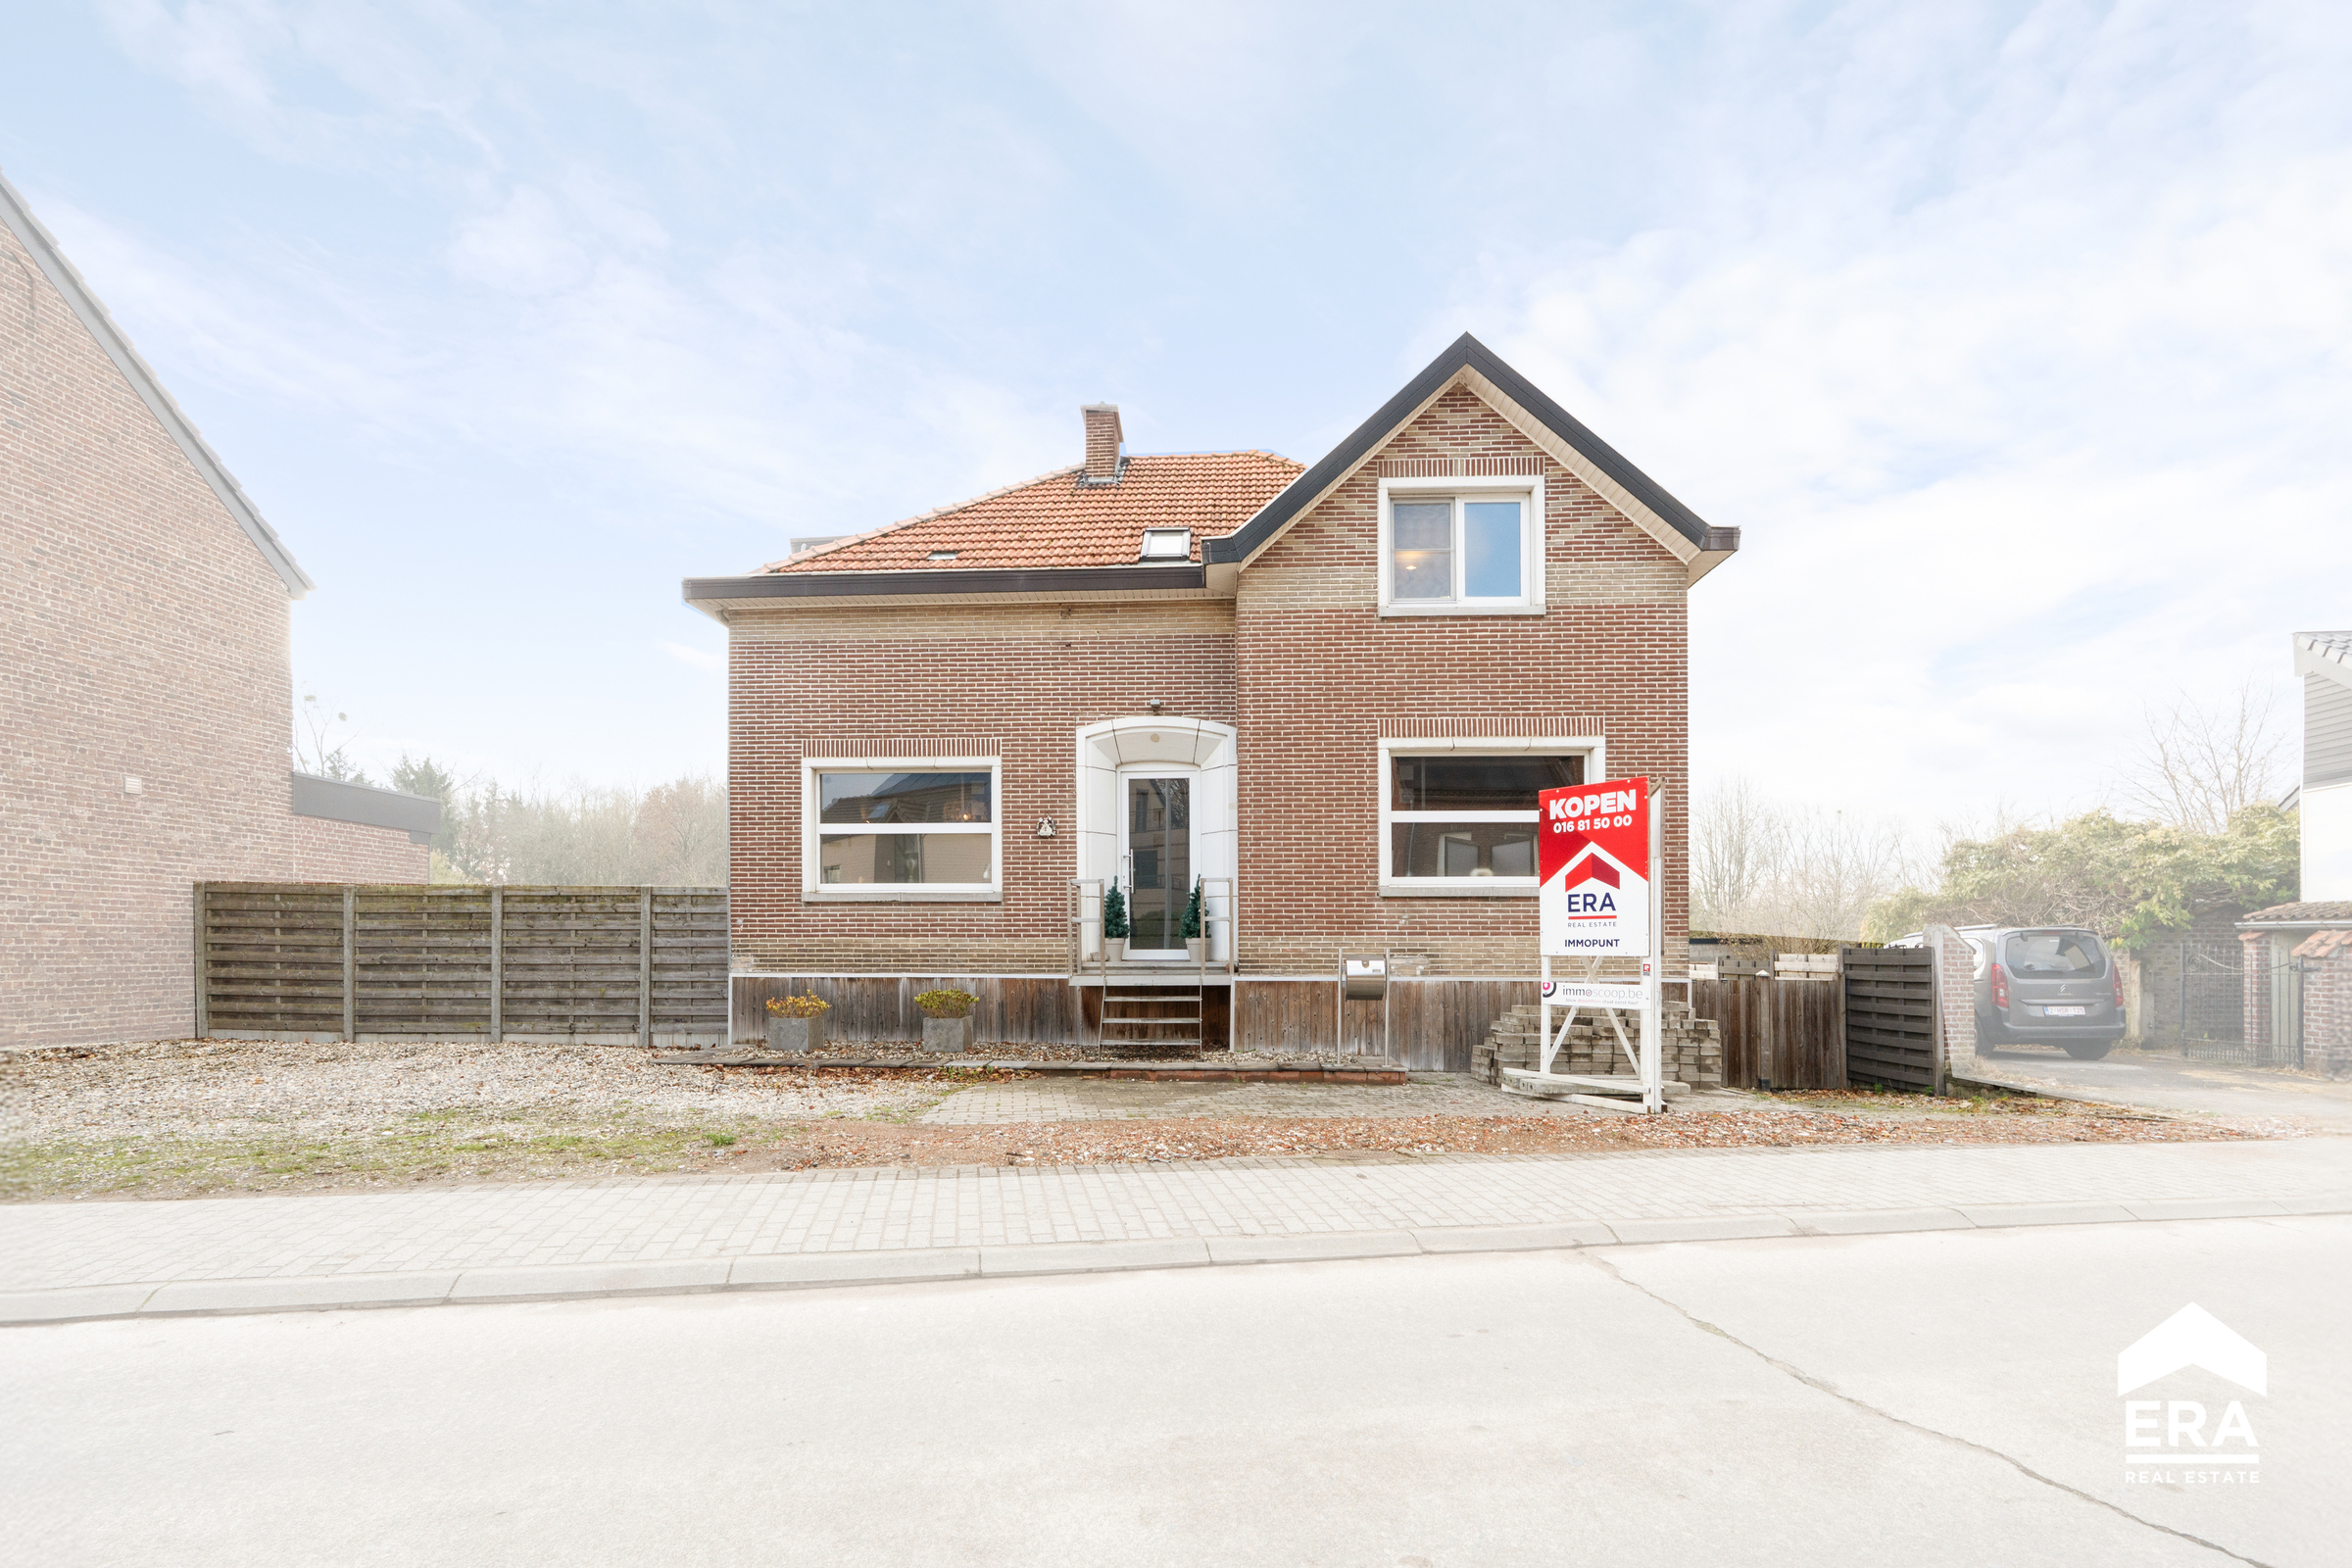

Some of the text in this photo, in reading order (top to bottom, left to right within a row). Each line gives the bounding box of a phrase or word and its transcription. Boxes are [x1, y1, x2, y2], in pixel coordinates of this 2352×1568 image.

[1549, 789, 1637, 820] KOPEN
[1553, 814, 1632, 833] 016 81 50 00
[1567, 892, 1616, 912] ERA
[1564, 939, 1620, 948] IMMOPUNT
[1562, 985, 1643, 1000] immoscoop.be
